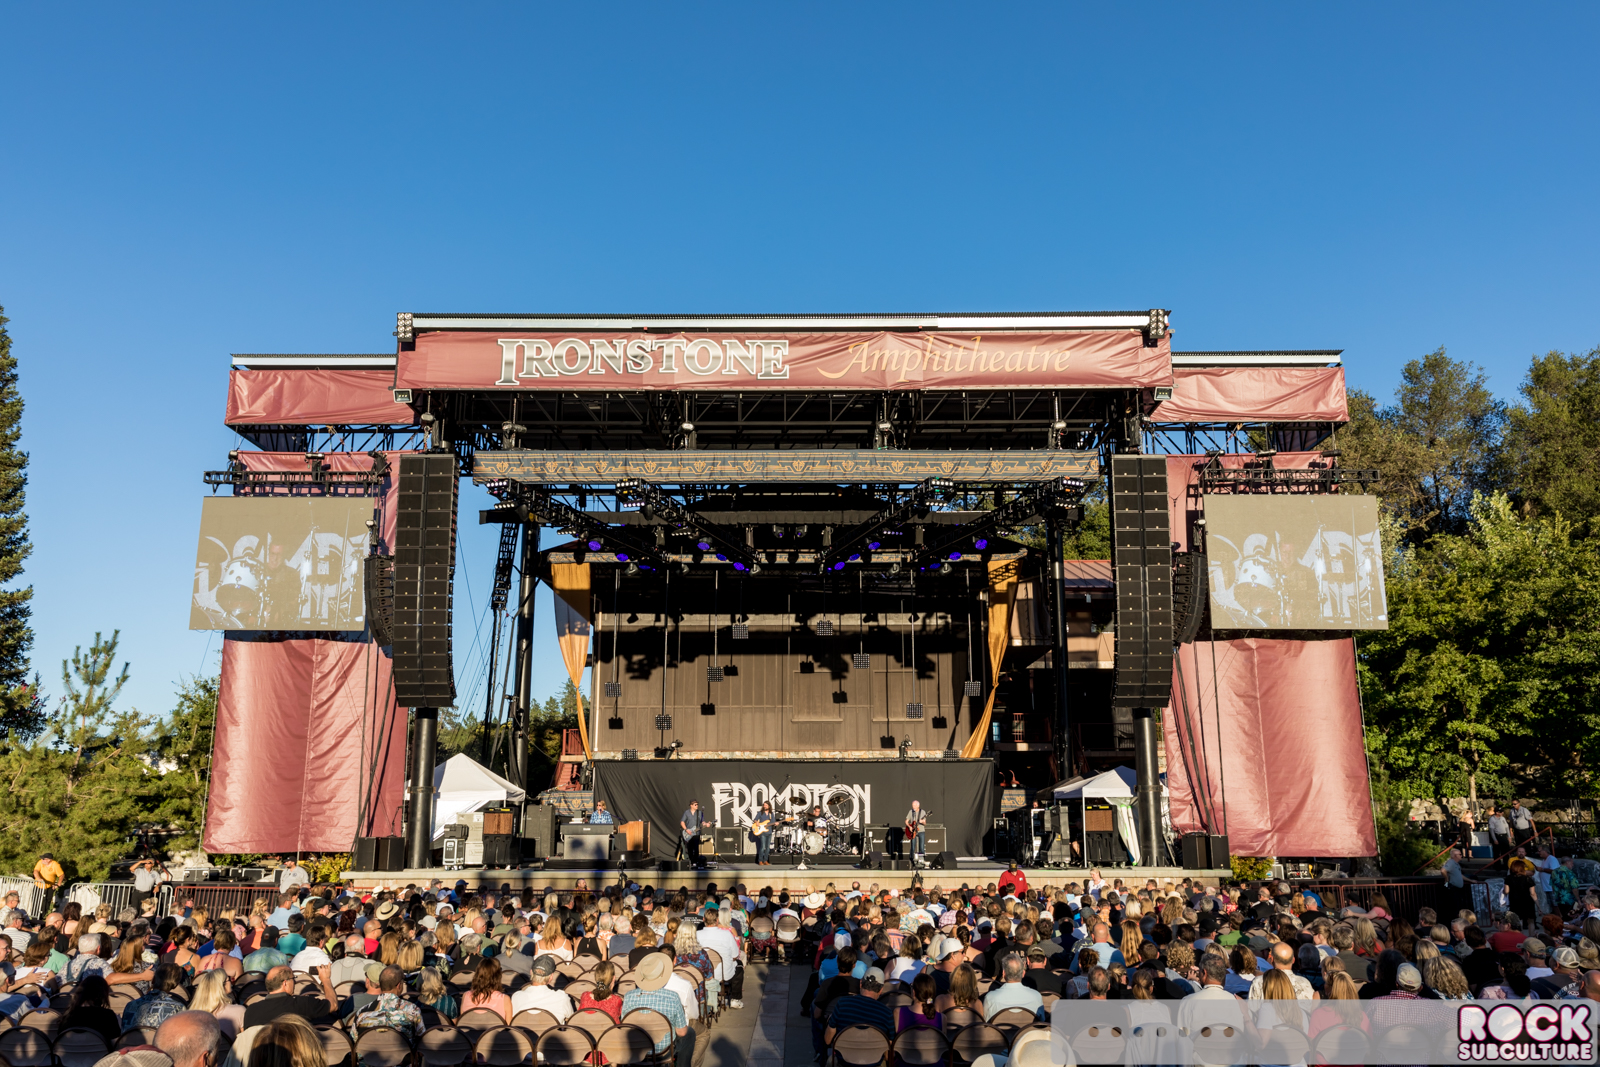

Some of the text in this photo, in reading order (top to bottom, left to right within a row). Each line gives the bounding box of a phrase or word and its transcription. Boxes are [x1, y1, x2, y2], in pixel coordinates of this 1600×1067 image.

[495, 335, 1071, 385] IRONSTONE Amphitheatre
[711, 782, 871, 831] FRAMPTON
